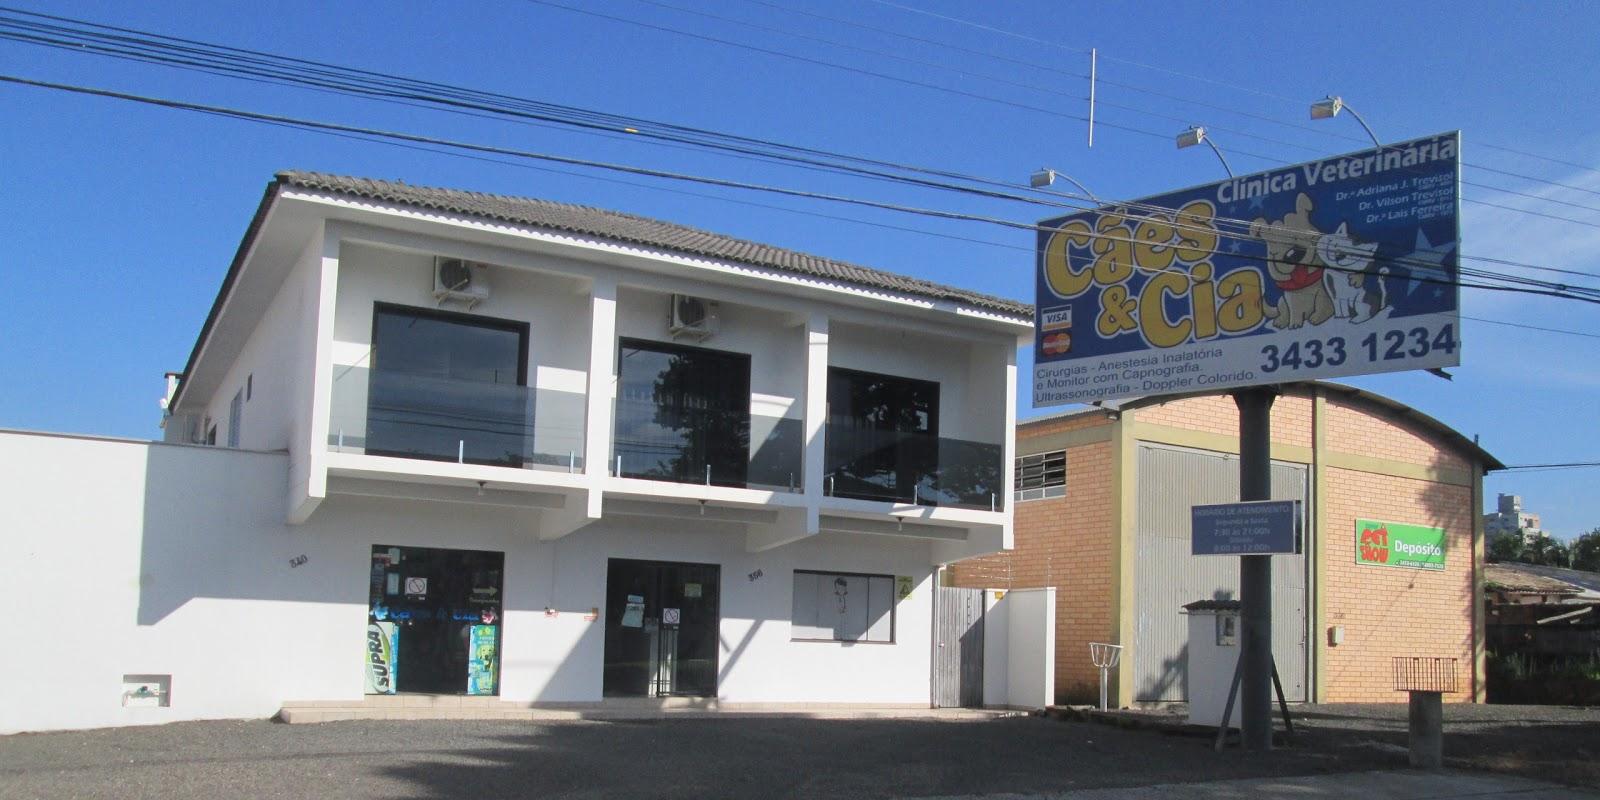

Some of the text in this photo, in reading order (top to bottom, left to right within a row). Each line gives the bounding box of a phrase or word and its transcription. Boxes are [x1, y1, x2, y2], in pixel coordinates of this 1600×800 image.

[1303, 137, 1456, 186] Veterinária
[1356, 184, 1399, 197] Adriana
[1400, 180, 1409, 189] J.
[1360, 201, 1374, 211] Dr.
[1377, 195, 1409, 207] Vilson
[1411, 202, 1454, 216] Ferreira
[1096, 261, 1265, 349] & Cia
[1046, 312, 1068, 323] VISA
[1260, 323, 1456, 373] 3433 1234
[1036, 366, 1088, 379] Cirurgias
[1098, 355, 1158, 371] Anestesia
[1163, 348, 1223, 363] Inalatória
[1036, 382, 1044, 390] e
[1047, 376, 1091, 389] Monitor
[1093, 372, 1118, 384] com
[1036, 384, 1130, 402] Ultrassonografia
[1142, 377, 1193, 391] Doppler
[1226, 506, 1236, 515] DE
[1236, 505, 1289, 515] ATENDIMENTO
[367, 630, 390, 688] SUPRA
